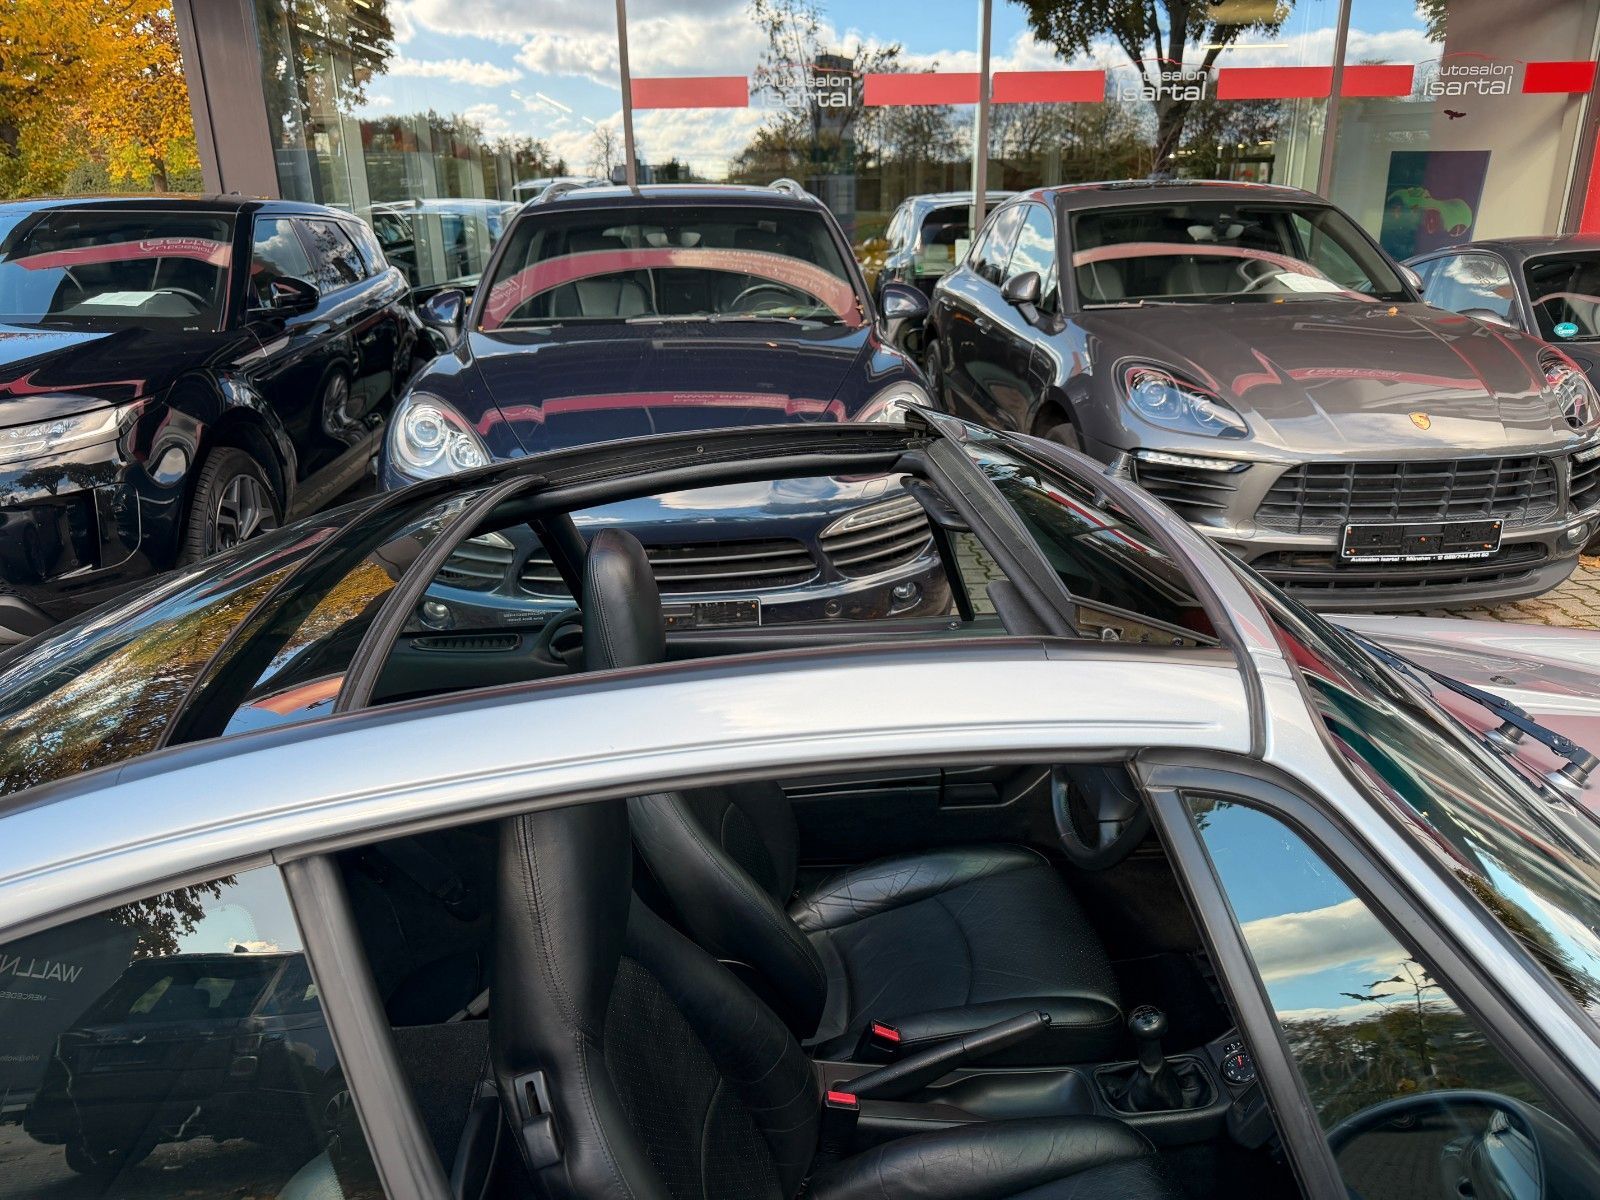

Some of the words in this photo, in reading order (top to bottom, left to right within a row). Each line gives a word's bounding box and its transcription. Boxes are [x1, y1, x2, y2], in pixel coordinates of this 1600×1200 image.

[761, 73, 853, 88] Autsalon
[1117, 69, 1207, 82] Atsalon
[1116, 81, 1207, 101] Isartal
[1423, 76, 1512, 96] Isartal
[760, 87, 852, 107] Isartal
